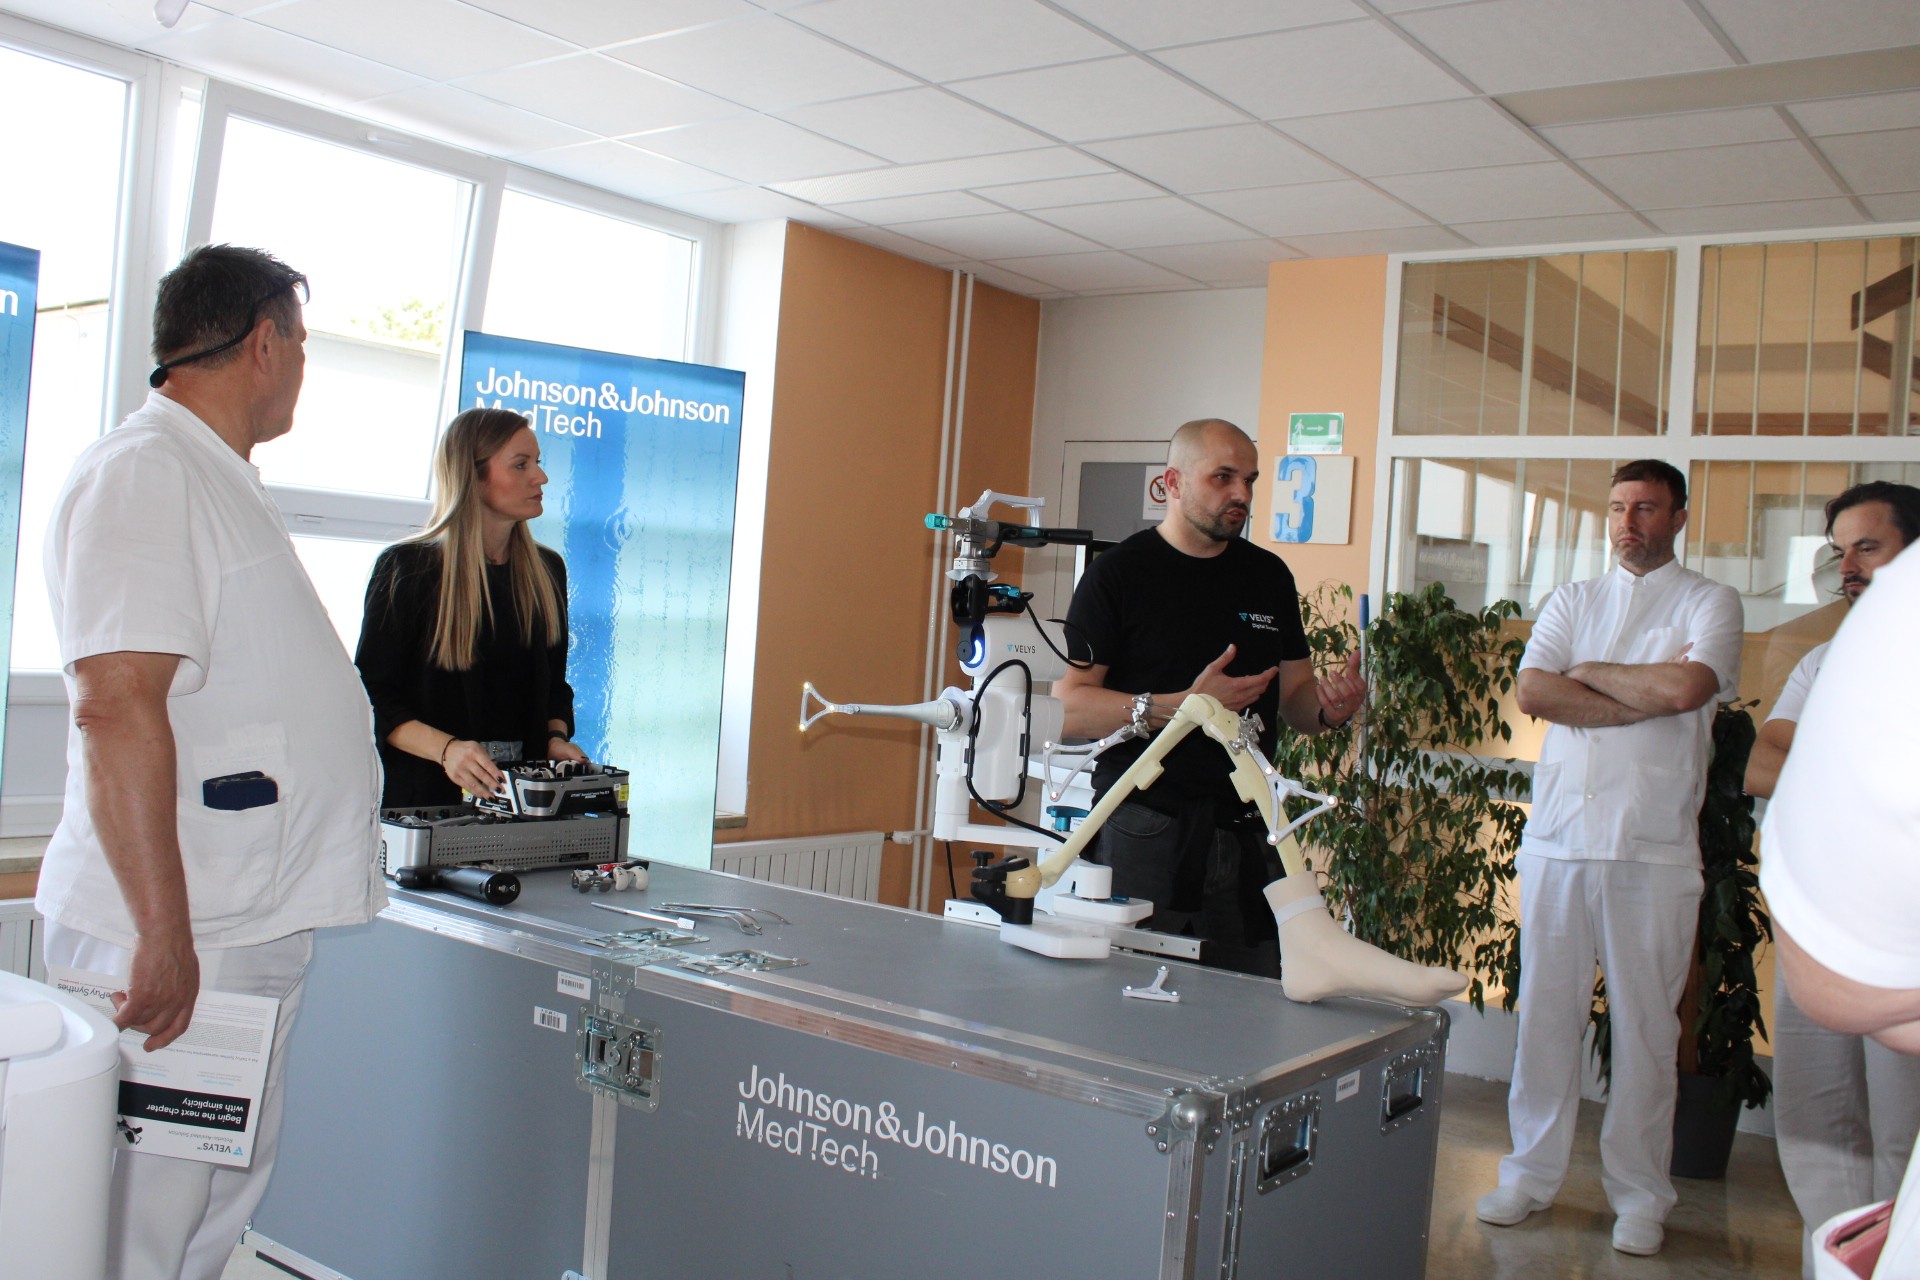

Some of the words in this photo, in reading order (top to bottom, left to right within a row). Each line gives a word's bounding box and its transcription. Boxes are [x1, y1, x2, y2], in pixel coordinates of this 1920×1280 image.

[476, 367, 729, 424] Johnson&Johnson
[476, 397, 602, 438] dTech
[1275, 455, 1317, 543] 3
[1014, 644, 1036, 654] VELYS
[57, 983, 89, 996] Synthes
[90, 988, 111, 999] ePuy
[146, 1104, 180, 1116] chapter
[182, 1097, 223, 1111] simplicity
[225, 1103, 244, 1113] with
[181, 1109, 200, 1117] next
[202, 1112, 216, 1121] the
[217, 1114, 242, 1125] Begin
[738, 1065, 1057, 1187] Johnson&Johnson
[736, 1102, 880, 1179] MedTech
